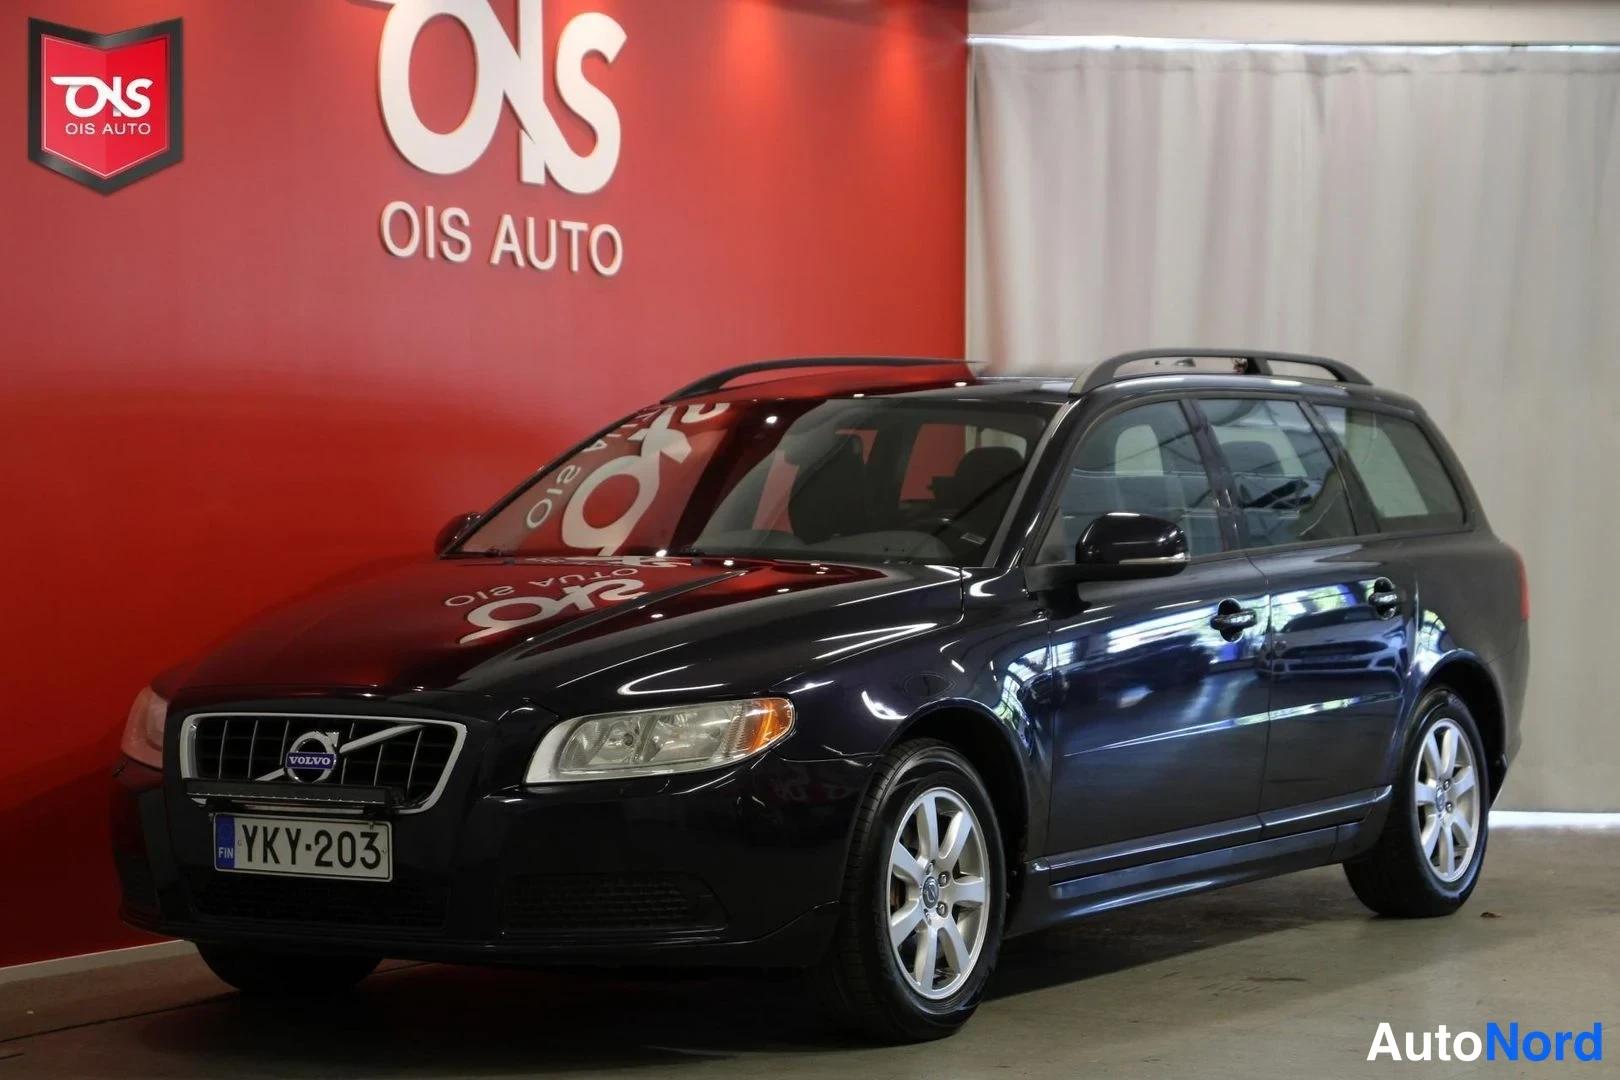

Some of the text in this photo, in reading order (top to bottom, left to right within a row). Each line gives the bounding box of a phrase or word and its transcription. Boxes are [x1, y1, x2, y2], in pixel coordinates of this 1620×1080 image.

[380, 200, 623, 276] OIS AUTO
[288, 756, 331, 766] VOLVO
[218, 846, 234, 859] FIN
